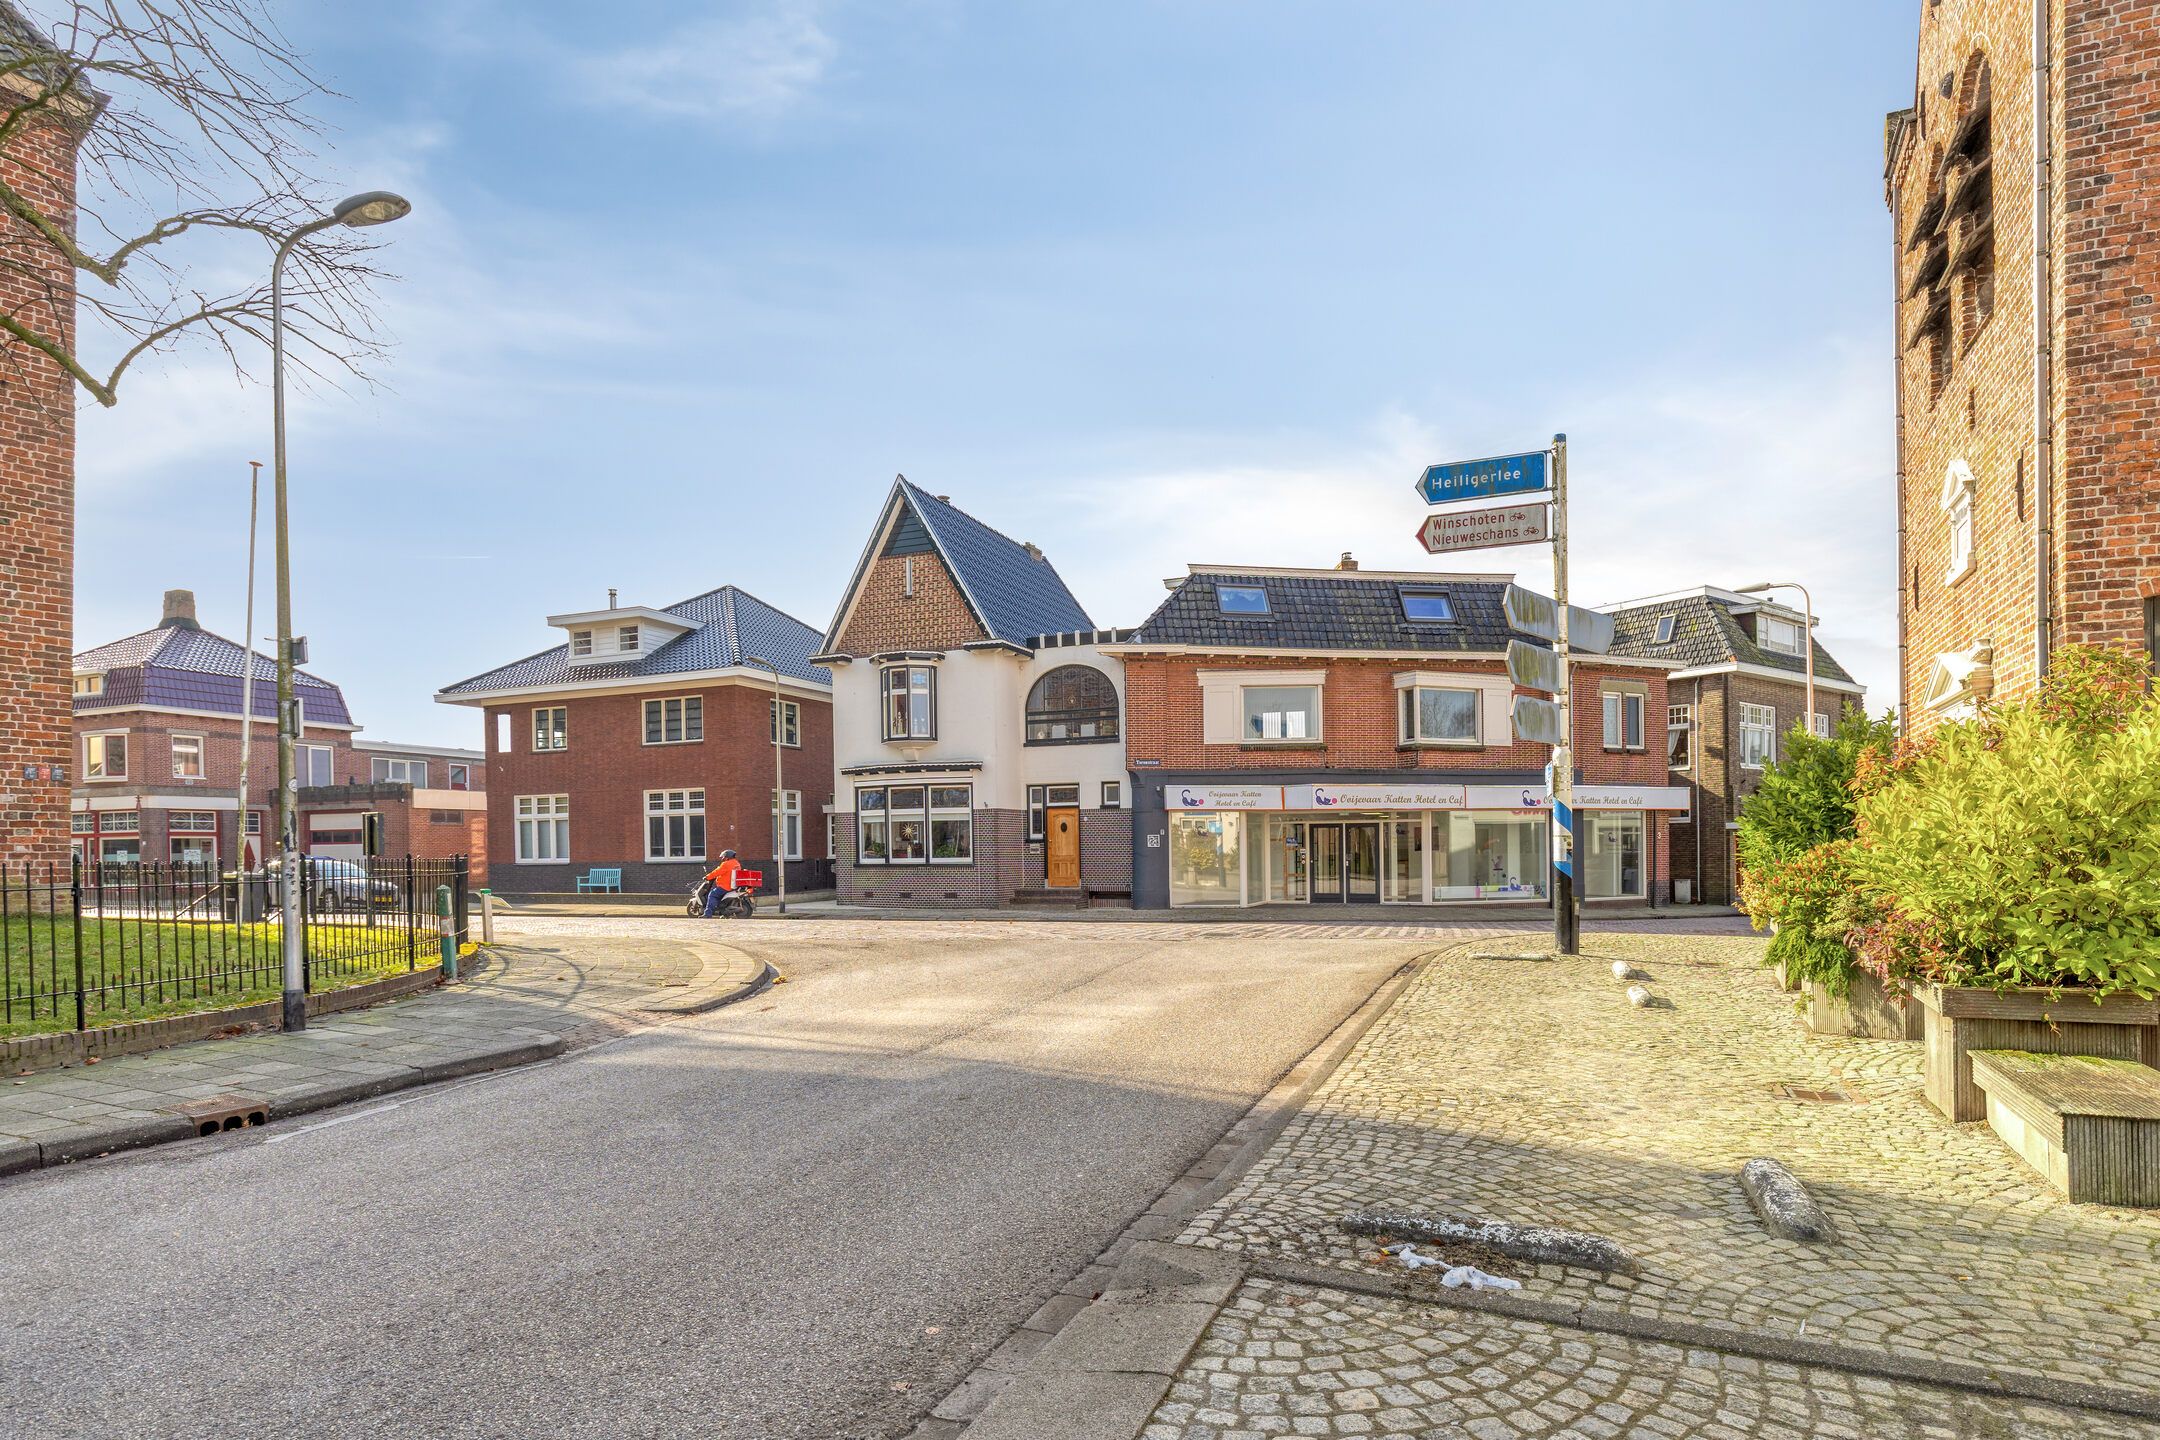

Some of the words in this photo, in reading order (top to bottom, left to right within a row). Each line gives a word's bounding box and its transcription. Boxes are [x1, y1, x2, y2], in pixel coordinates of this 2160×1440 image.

[1432, 469, 1521, 490] Heiligerlee
[1433, 512, 1505, 530] Winschoten
[1432, 527, 1519, 546] Nieuweschans
[1240, 790, 1262, 798] Katten
[1384, 794, 1412, 804] Katten
[1413, 794, 1436, 804] Hotel
[1215, 799, 1232, 807] Hotel
[1241, 799, 1257, 808] Café
[1579, 795, 1601, 805] Katten
[1602, 795, 1620, 805] Hotel
[1629, 795, 1643, 807] Café
